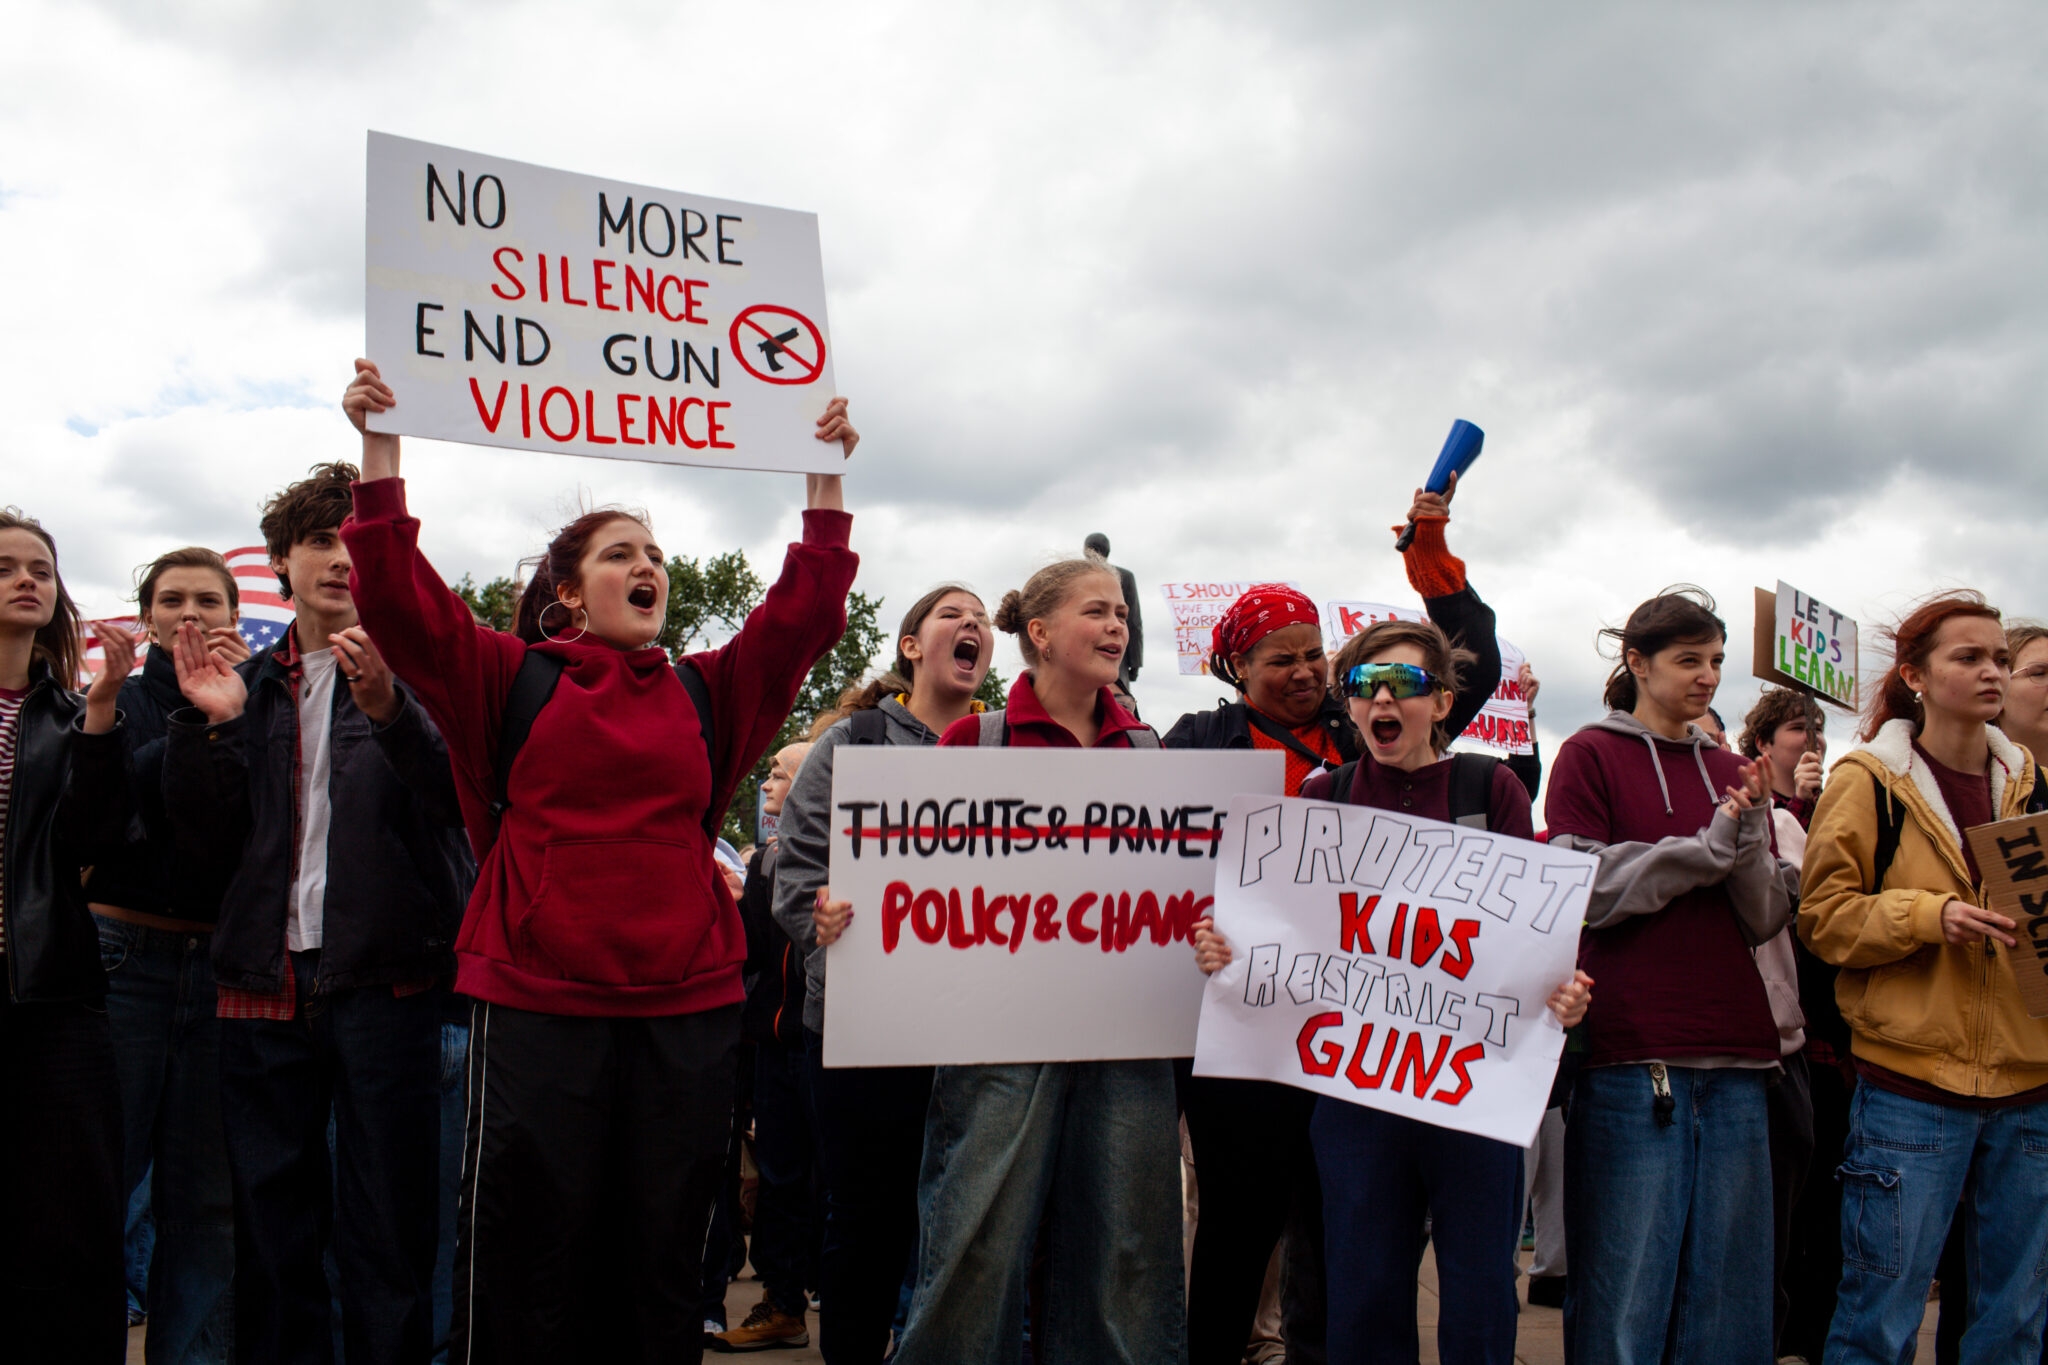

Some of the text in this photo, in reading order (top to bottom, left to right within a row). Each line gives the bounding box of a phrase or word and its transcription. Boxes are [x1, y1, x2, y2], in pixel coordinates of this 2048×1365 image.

[427, 163, 743, 266] NO MORE
[491, 247, 709, 325] SILENCE
[416, 303, 720, 389] END GUN
[468, 377, 735, 449] VIOLENCE
[1162, 583, 1262, 599] I SHOUL
[1176, 615, 1223, 626] WORR
[1795, 590, 1843, 636] LET
[1780, 635, 1854, 703] LEARN
[1791, 618, 1842, 663] KIDS
[1240, 804, 1592, 934] PROTECT
[1339, 892, 1481, 980] KIDS
[1296, 1011, 1485, 1105] GUNS
